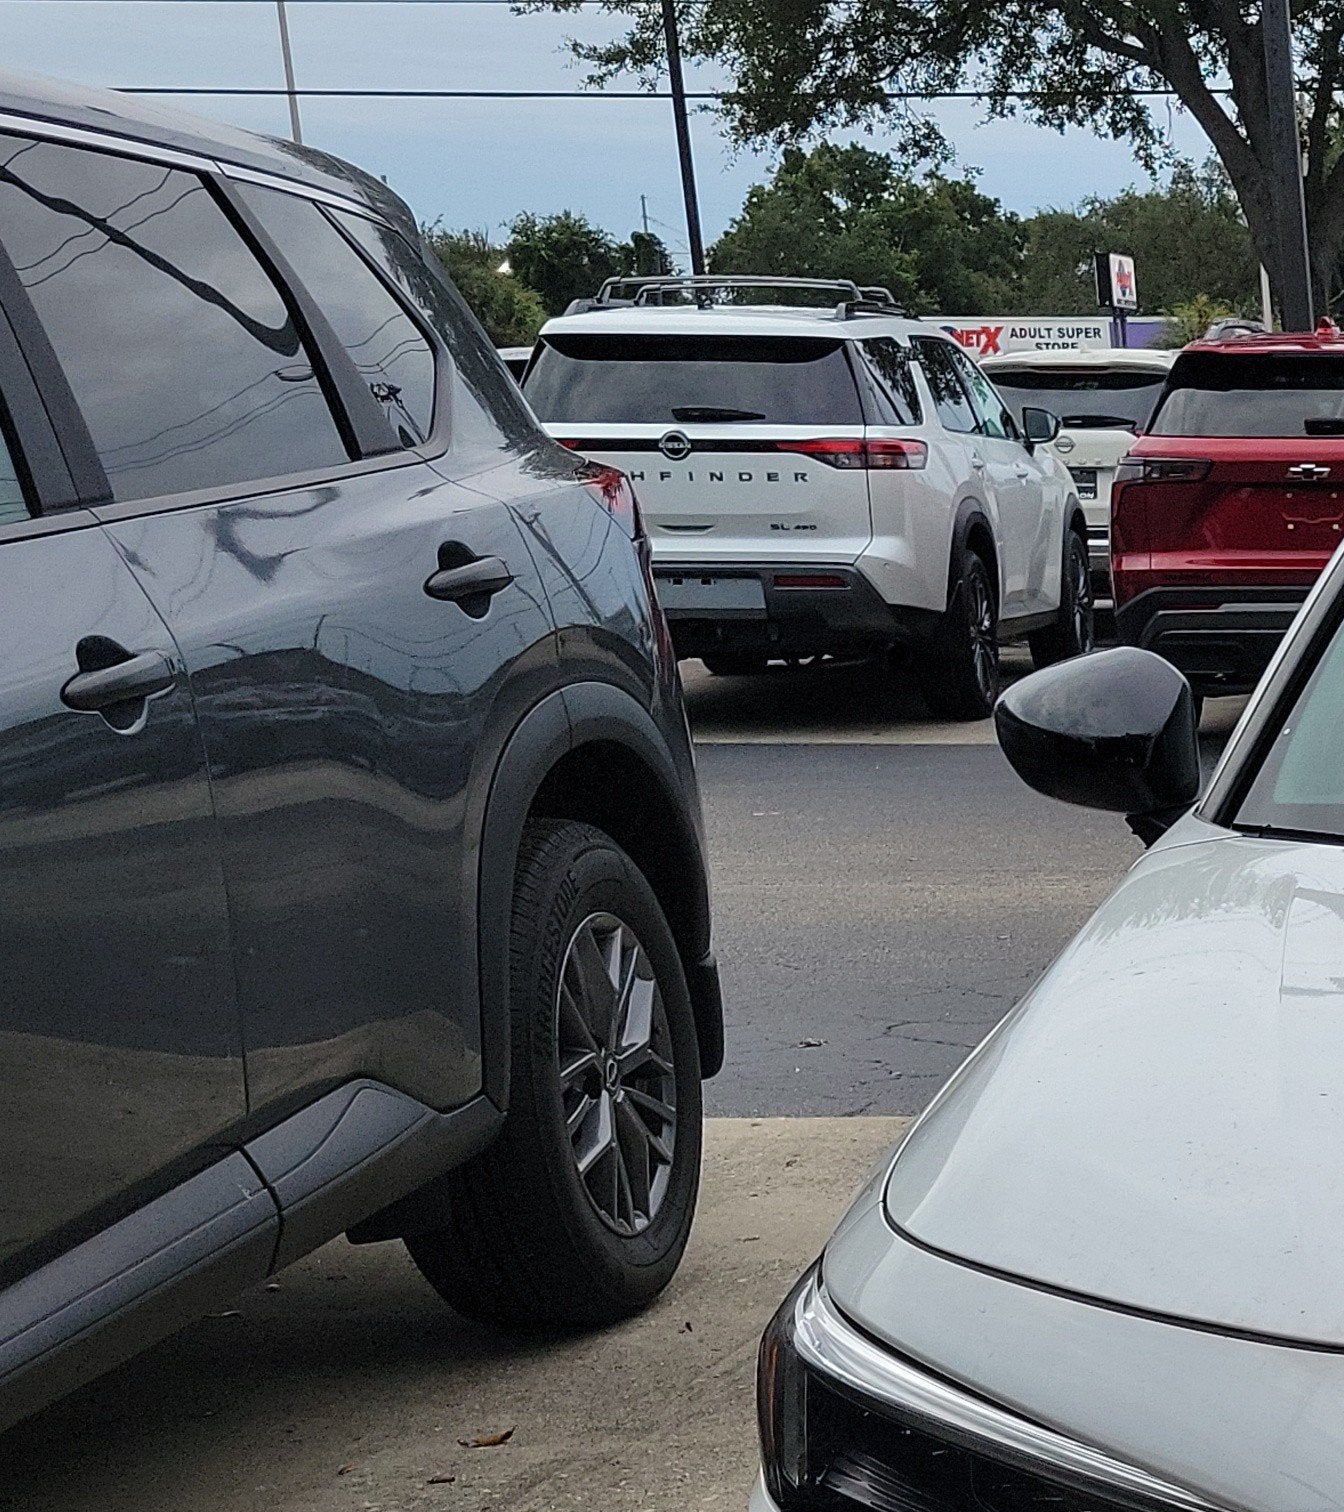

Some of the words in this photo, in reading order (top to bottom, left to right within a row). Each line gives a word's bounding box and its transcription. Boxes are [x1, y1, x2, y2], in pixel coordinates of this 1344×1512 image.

[1009, 328, 1051, 339] ADULT
[1057, 328, 1102, 339] SUPER
[630, 470, 809, 482] HFINDER
